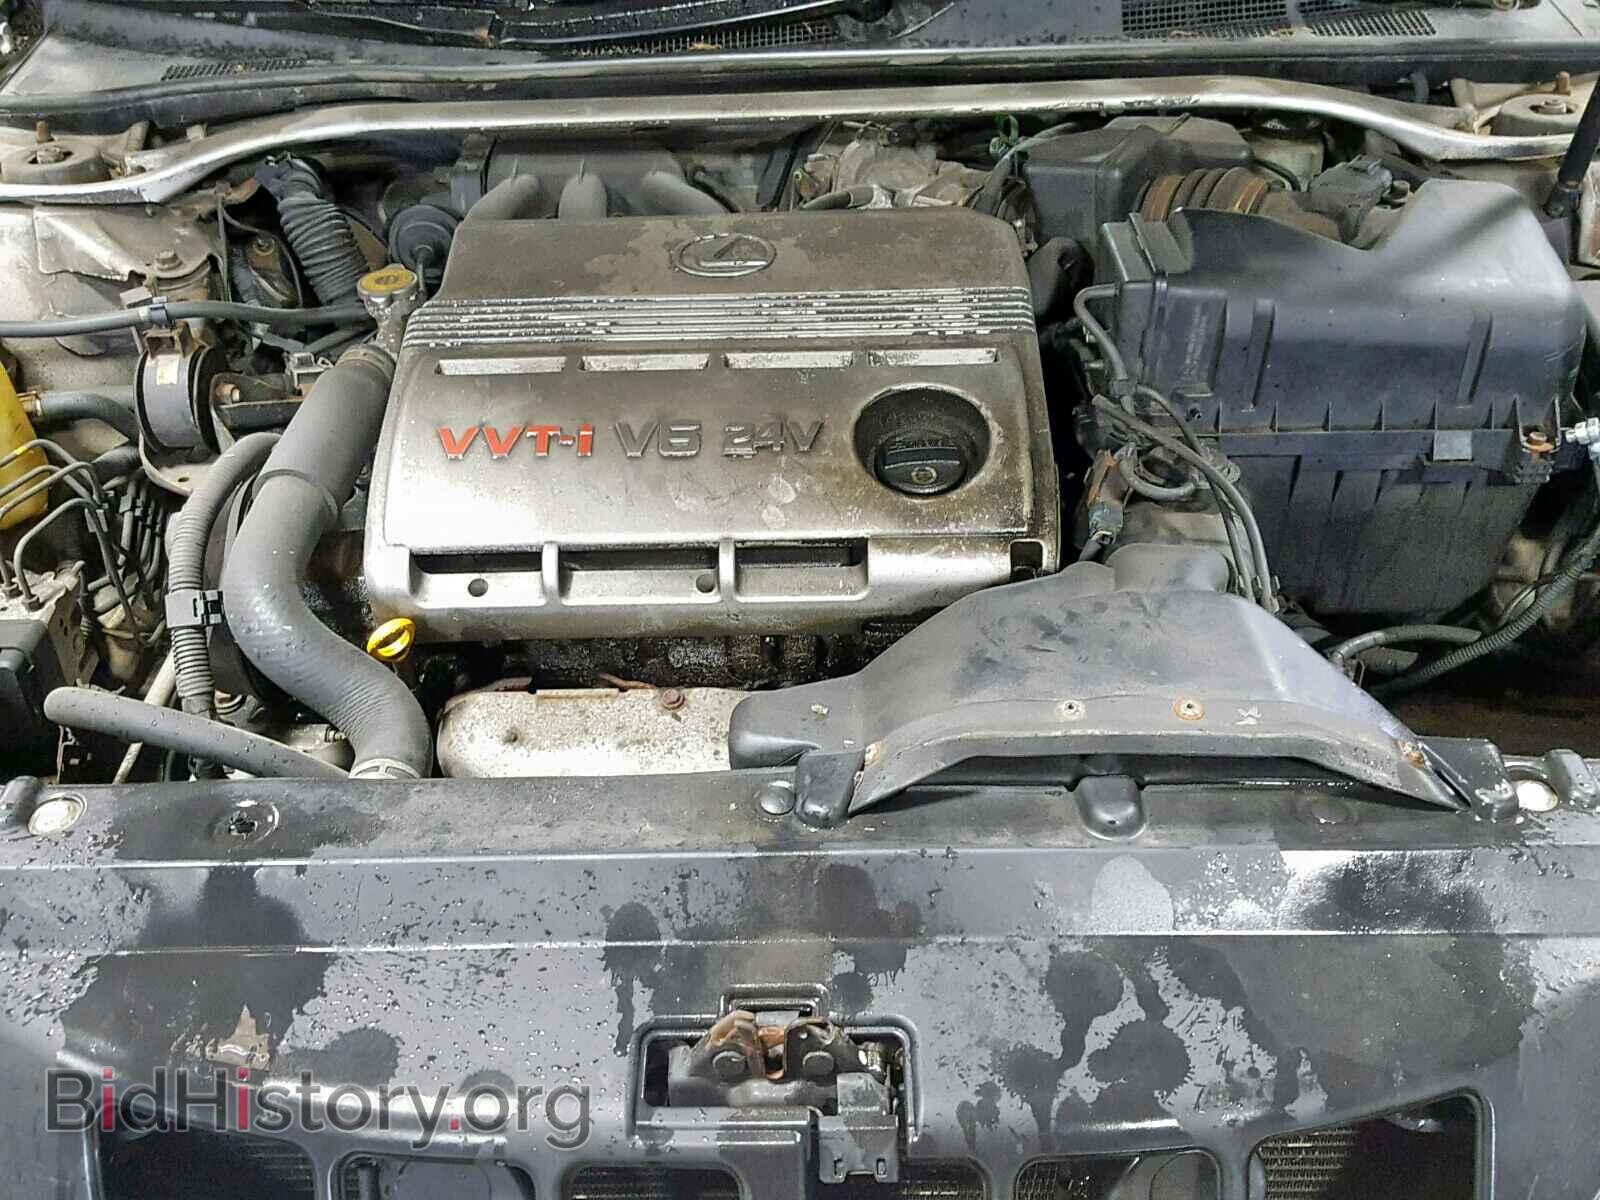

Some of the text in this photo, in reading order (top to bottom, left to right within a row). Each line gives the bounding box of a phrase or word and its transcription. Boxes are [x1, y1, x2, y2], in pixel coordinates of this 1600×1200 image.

[438, 420, 824, 460] VVT-i V6 24V
